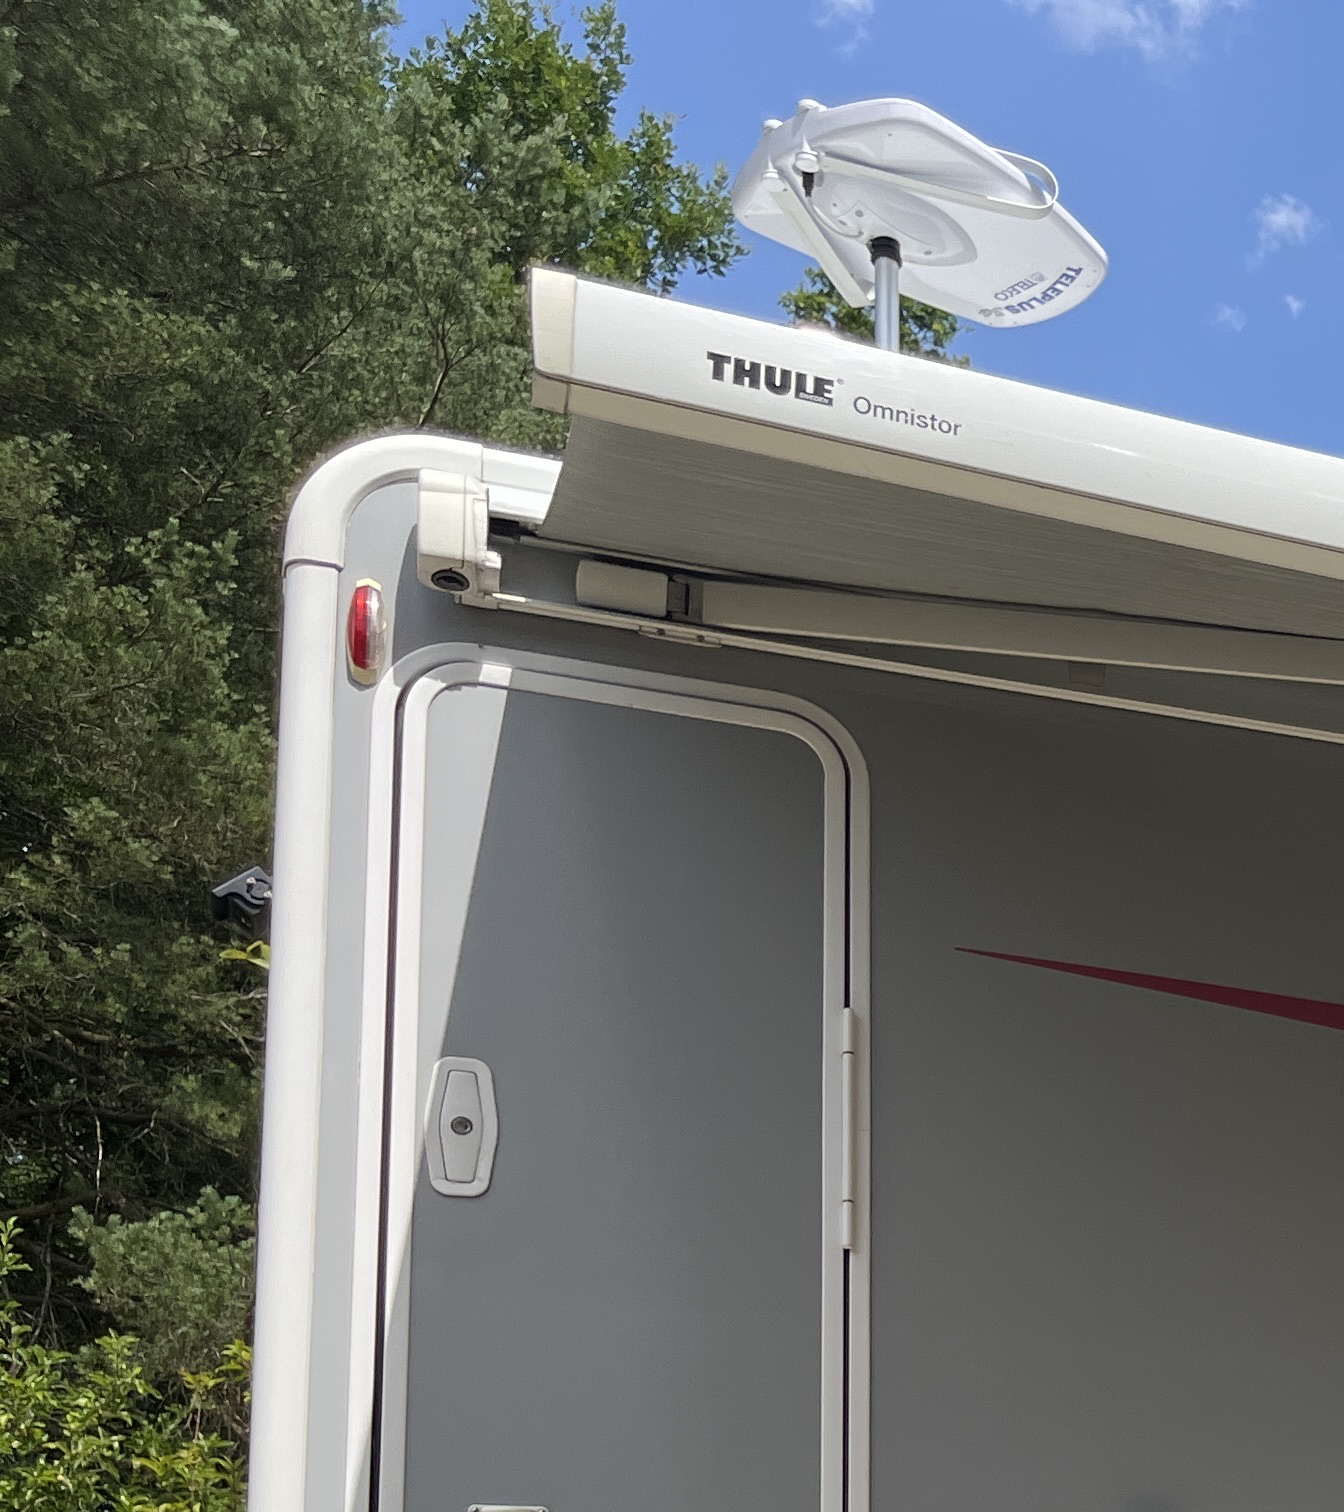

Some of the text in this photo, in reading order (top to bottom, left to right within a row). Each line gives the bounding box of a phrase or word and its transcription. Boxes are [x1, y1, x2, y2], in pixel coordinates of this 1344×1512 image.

[1004, 266, 1084, 314] TELEPLUS
[706, 350, 963, 436] THULE Omnistor
